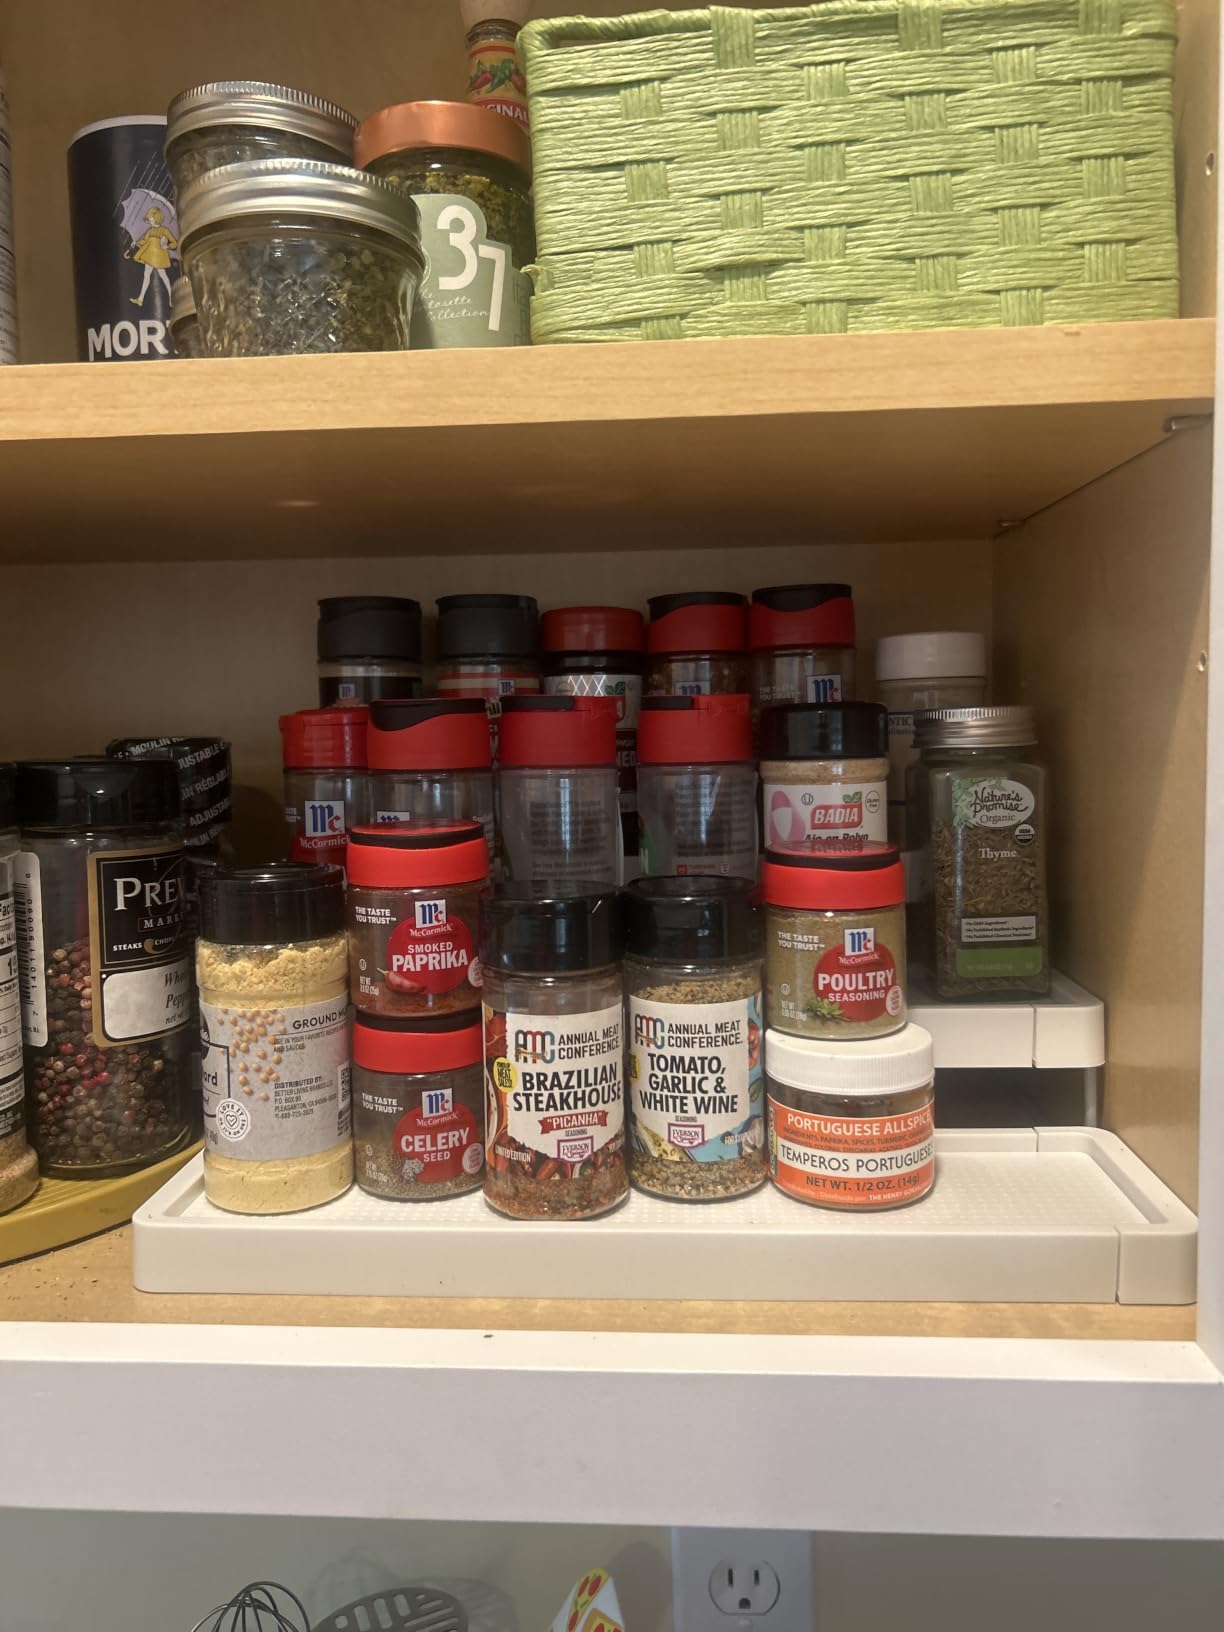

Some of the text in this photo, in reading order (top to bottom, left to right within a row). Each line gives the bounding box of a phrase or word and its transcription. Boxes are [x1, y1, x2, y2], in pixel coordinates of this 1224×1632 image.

[87, 320, 171, 361] MOR
[973, 786, 1023, 804] Nature's
[814, 807, 858, 824] BADIA
[970, 801, 1029, 819] Promise
[980, 813, 1016, 825] Organic
[978, 847, 1017, 862] Thyme
[355, 906, 391, 917] THE TASTE
[356, 915, 367, 923] YOU
[409, 924, 453, 938] McCormick
[778, 931, 819, 943] THE TASTE
[112, 942, 143, 952] STEAKS
[407, 941, 453, 954] SMOKED
[778, 939, 791, 948] YOU
[392, 948, 468, 972] PAPRIKA
[838, 953, 879, 965] McCormick
[818, 968, 894, 991] POULTRY
[828, 989, 886, 1002] SEASONING
[292, 1012, 338, 1030] GROUND
[667, 1023, 711, 1035] ANNUAL
[715, 1019, 741, 1034] MEAT
[558, 1031, 600, 1046] ANNUAL
[602, 1023, 620, 1040] MEAT
[558, 1037, 620, 1060] CONFERENCE
[648, 1053, 726, 1075] TOMATO,
[274, 1077, 313, 1090] DISTRIBUTED
[521, 1062, 617, 1091] BRAZILIAN
[648, 1073, 727, 1095] GARLIC &
[362, 1092, 398, 1106] THE TASTE
[512, 1082, 621, 1112] STEAKHOUSE
[640, 1090, 739, 1115] WHITE WINE
[362, 1101, 374, 1110] YOU
[416, 1112, 458, 1127] McCormick
[787, 1110, 931, 1136] PORTUGUESE ALLSPICE
[400, 1127, 470, 1153] CELERY
[423, 1151, 451, 1162] SEED
[780, 1144, 850, 1172] TEMPEROS
[806, 1175, 826, 1189] NET
[831, 1180, 852, 1191] WT.
[856, 1181, 876, 1191] 1/2
[877, 1179, 895, 1190] OZ.
